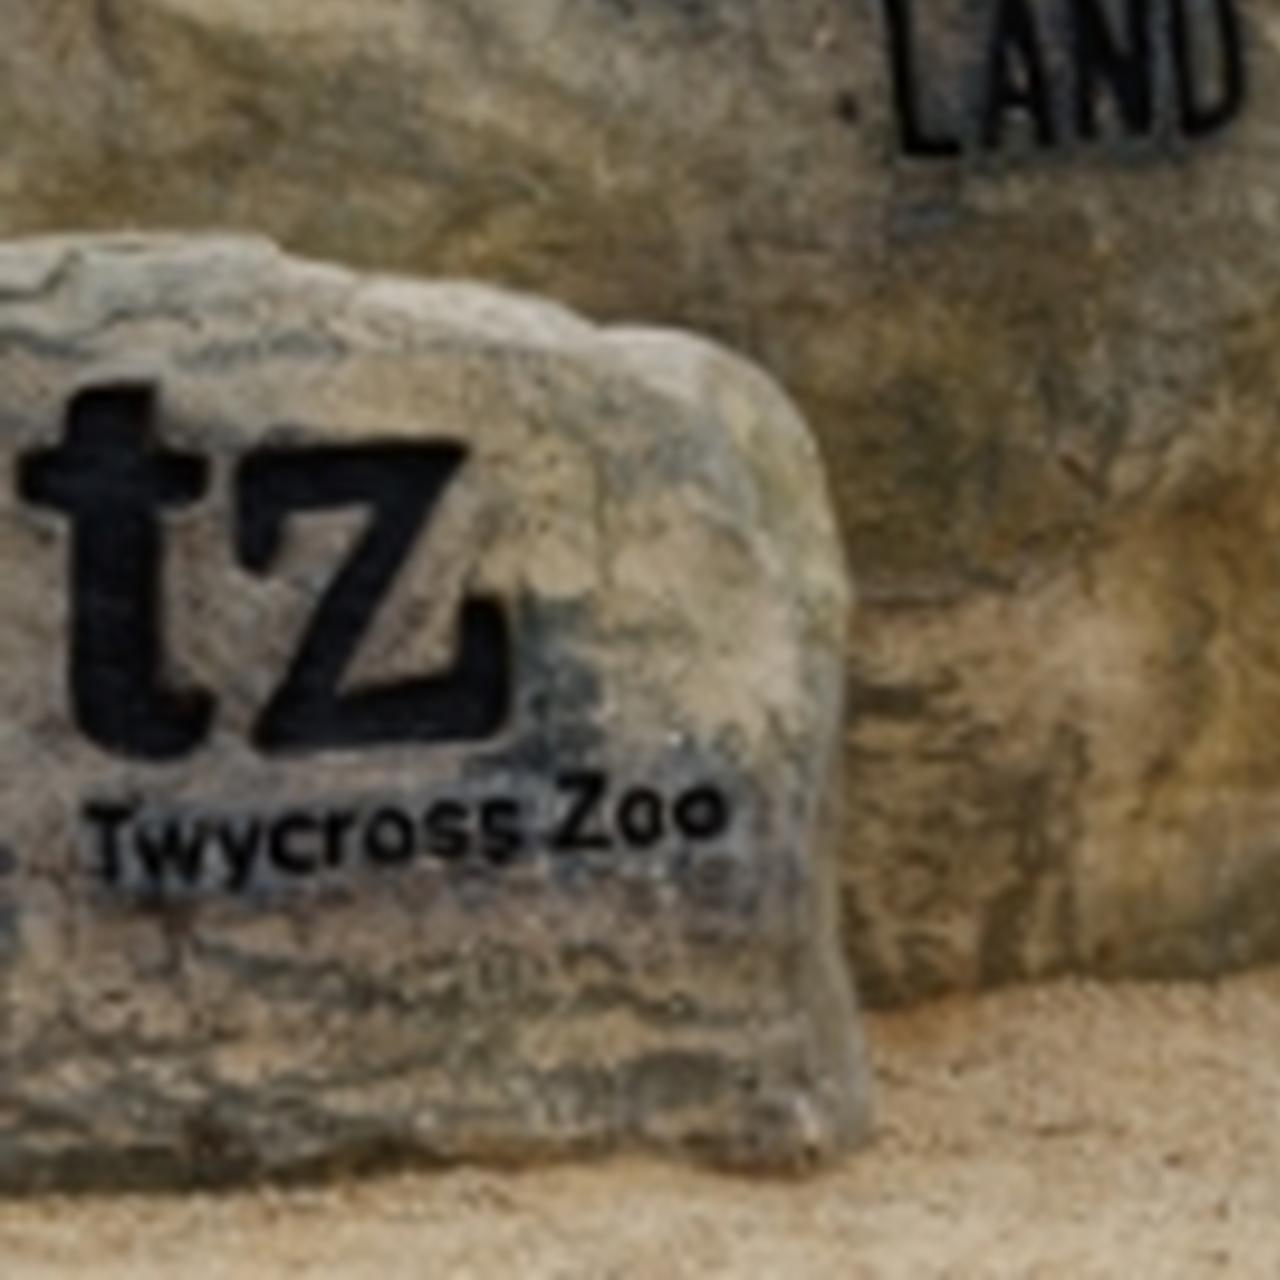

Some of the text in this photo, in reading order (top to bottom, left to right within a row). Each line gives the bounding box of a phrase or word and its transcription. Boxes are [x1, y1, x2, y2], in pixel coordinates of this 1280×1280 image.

[18, 381, 510, 760] tz
[83, 774, 728, 891] Twycross Zoo
